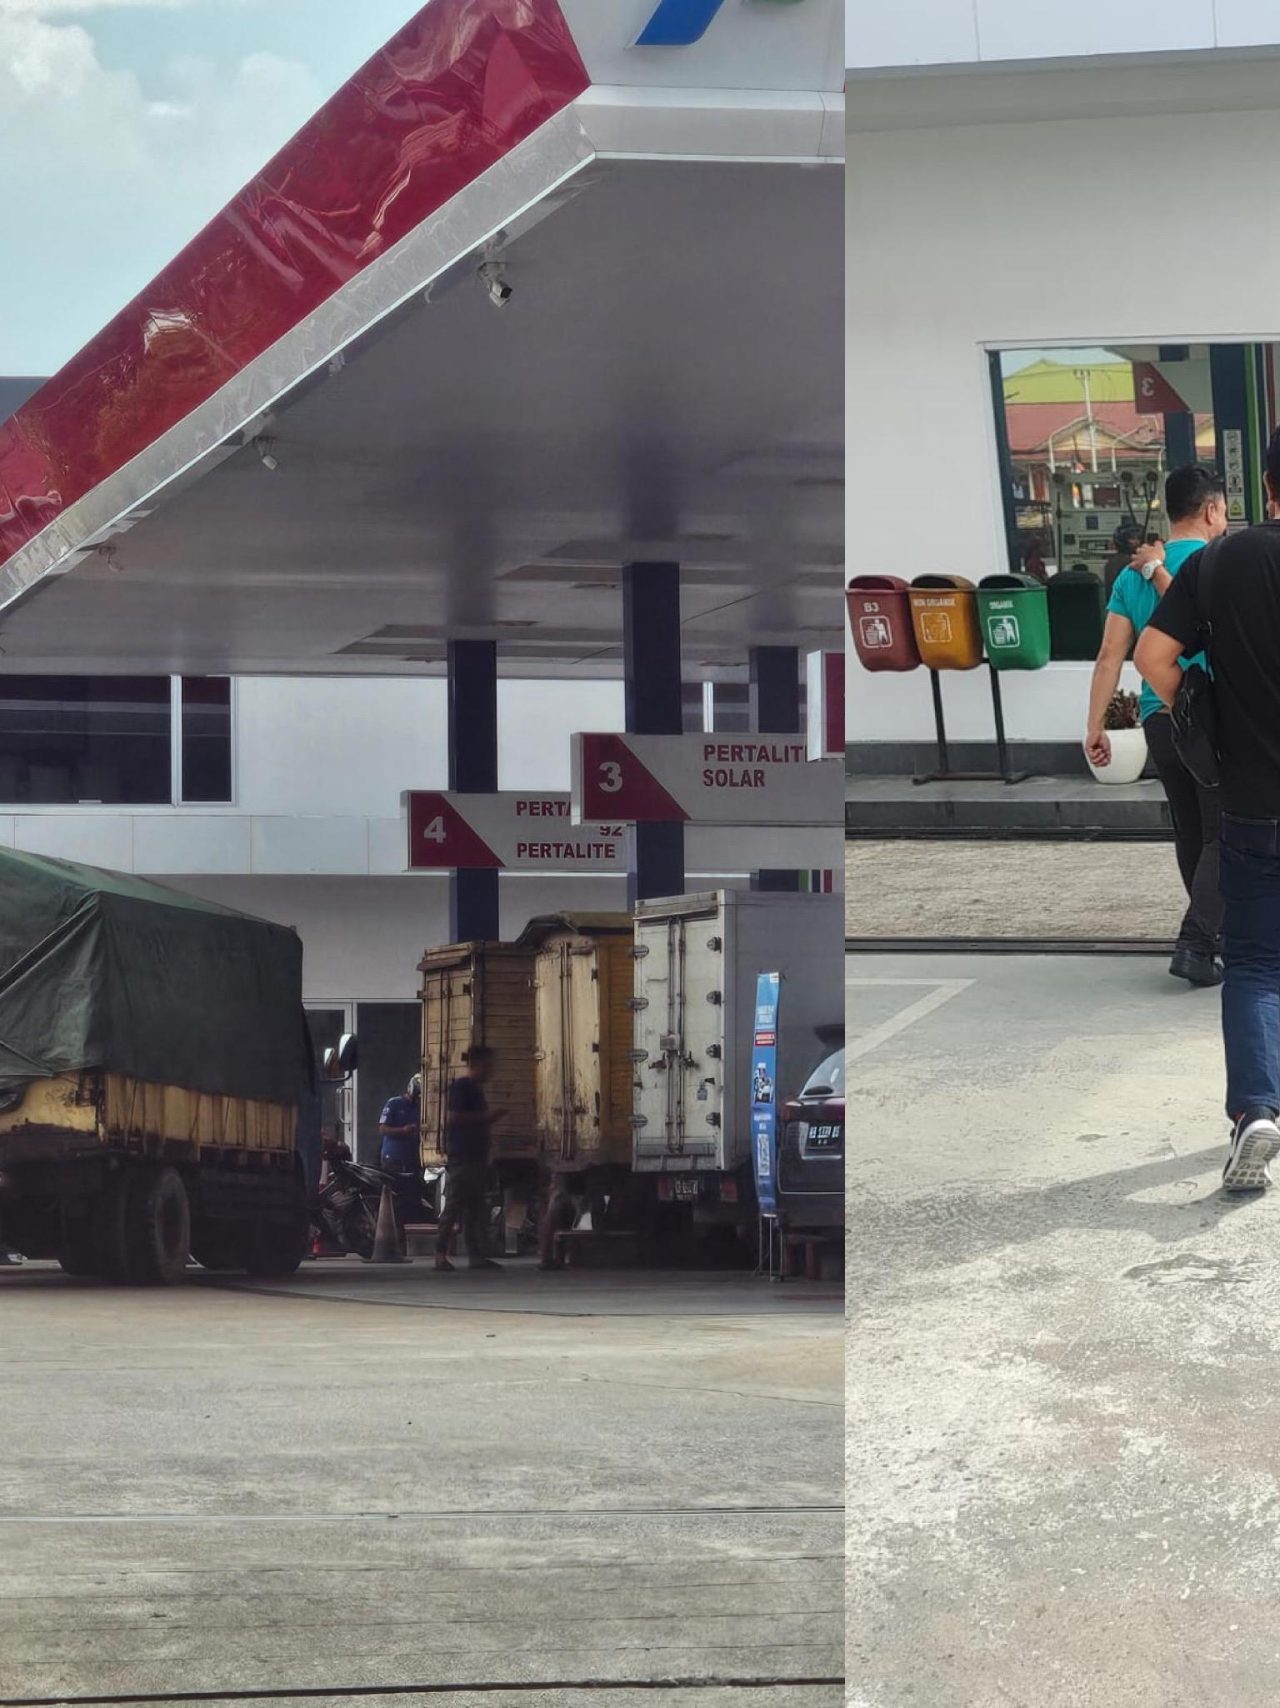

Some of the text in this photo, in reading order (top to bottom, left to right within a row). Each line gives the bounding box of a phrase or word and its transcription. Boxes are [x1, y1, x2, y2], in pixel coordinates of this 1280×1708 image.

[863, 601, 879, 612] B3
[703, 744, 808, 763] PERTALIT
[599, 761, 623, 792] 3
[703, 768, 766, 787] SOLAR
[424, 815, 447, 844] 4
[600, 825, 623, 837] 92
[517, 842, 616, 859] PERTALITE
